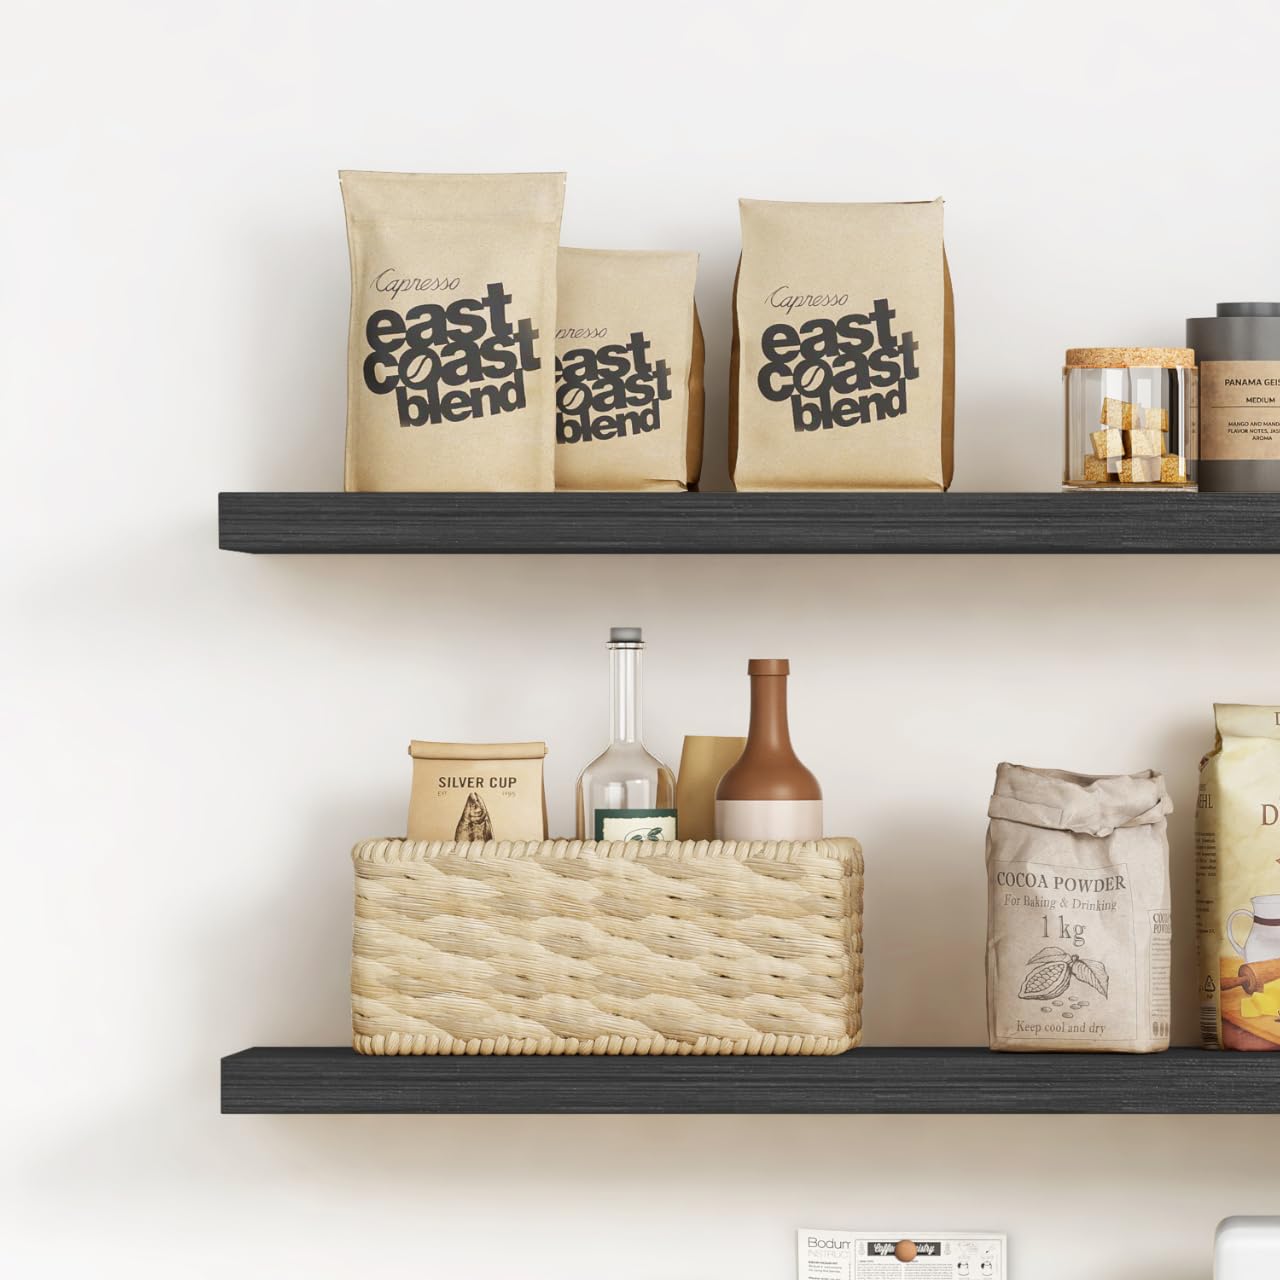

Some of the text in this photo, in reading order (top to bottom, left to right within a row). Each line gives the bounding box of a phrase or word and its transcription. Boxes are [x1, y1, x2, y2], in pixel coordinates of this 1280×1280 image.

[370, 267, 460, 300] Capresso
[765, 285, 849, 315] Capresso
[366, 282, 512, 352] east
[761, 298, 896, 364] east
[363, 318, 541, 395] coast
[555, 331, 651, 383] ast
[757, 331, 920, 402] coast
[396, 368, 527, 428] blend
[555, 359, 672, 415] oast
[790, 378, 908, 432] blend
[556, 398, 661, 444] blend
[438, 776, 517, 788] SILVER CUP
[997, 871, 1126, 893] COCOA POWDER
[1003, 894, 1117, 912] For Baking & Drinking
[1042, 914, 1086, 947] 1 kg
[1016, 1020, 1106, 1036] Keep cool and dry
